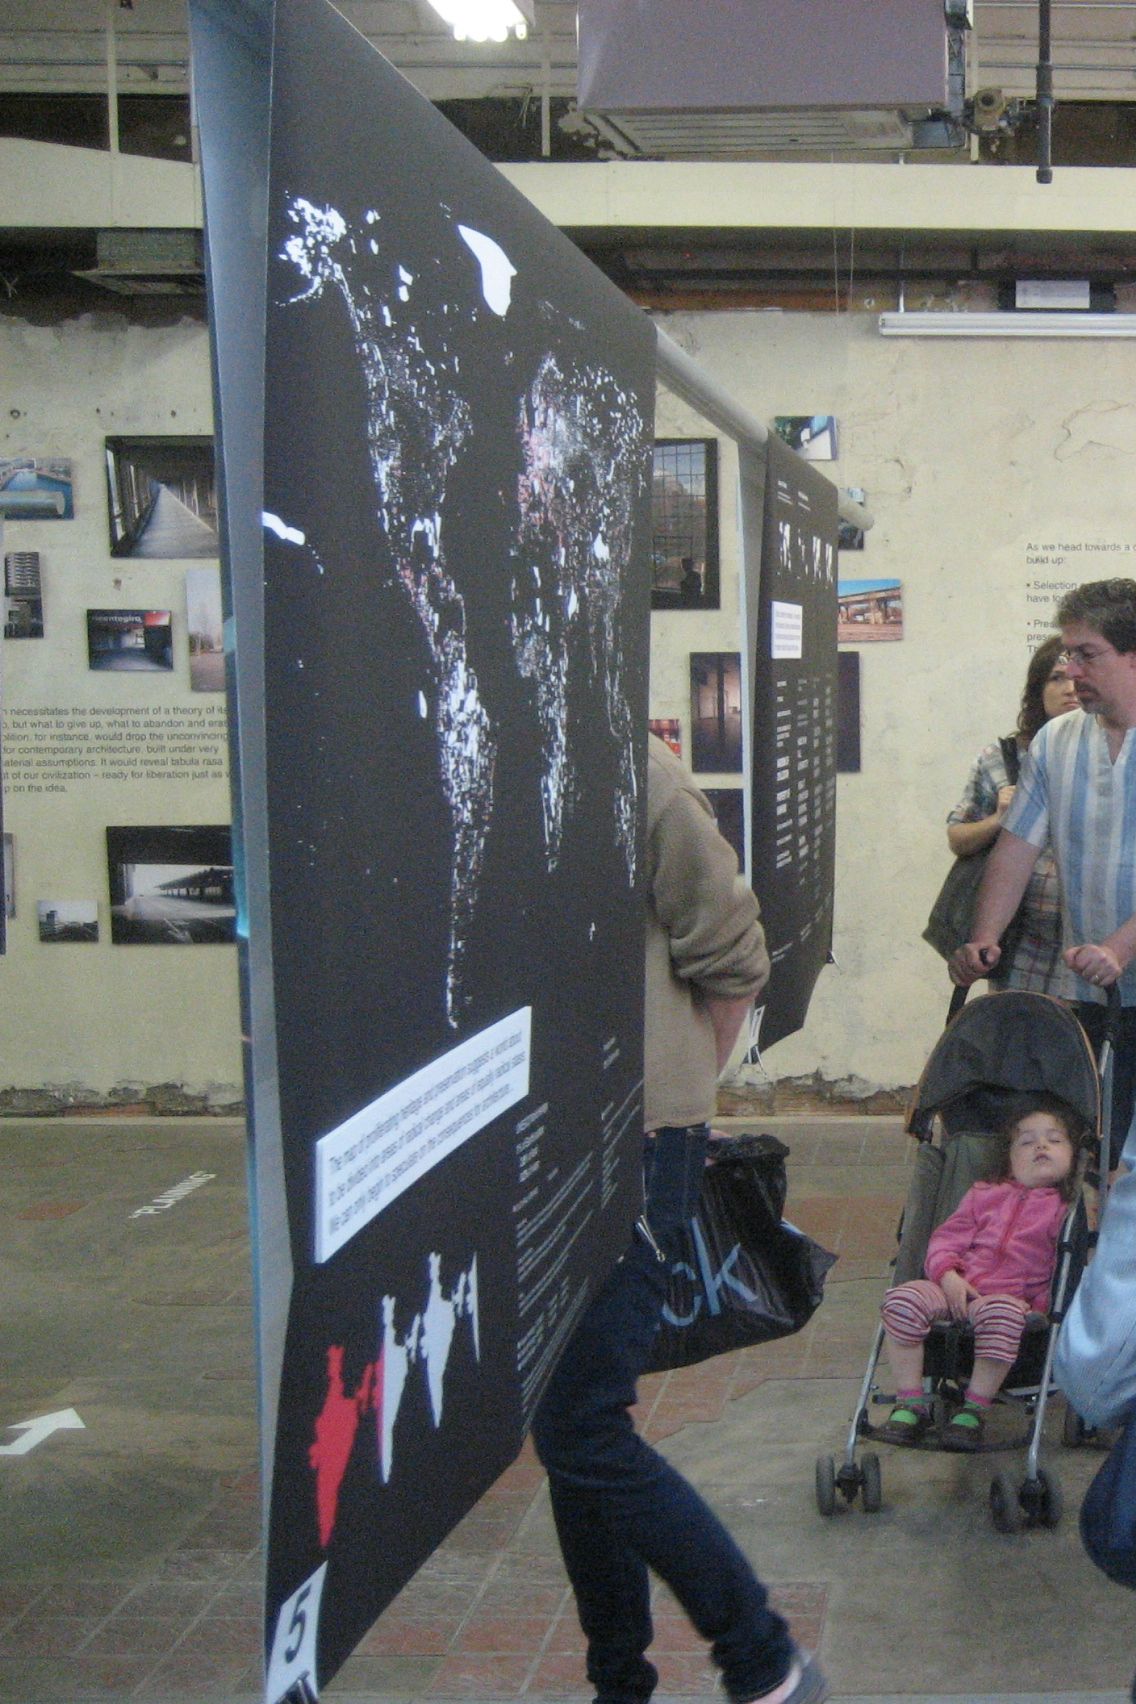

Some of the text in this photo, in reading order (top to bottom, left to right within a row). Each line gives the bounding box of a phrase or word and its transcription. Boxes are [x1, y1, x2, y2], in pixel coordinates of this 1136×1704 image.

[1058, 542, 1081, 551] head
[1085, 542, 1121, 551] towards
[1034, 581, 1077, 590] Selection
[72, 707, 87, 715] the
[90, 706, 149, 716] development
[152, 706, 161, 715] of
[172, 706, 202, 716] theory
[30, 720, 53, 728] what
[67, 720, 87, 730] give
[106, 720, 129, 728] what
[144, 720, 184, 728] abandon
[187, 720, 206, 728] and
[126, 733, 146, 741] drop
[149, 732, 164, 740] the
[18, 746, 83, 755] contemporary
[169, 745, 195, 753] under
[110, 758, 137, 766] would
[42, 772, 91, 780] civilization
[102, 771, 128, 780] ready
[146, 771, 189, 779] liberation
[285, 1583, 311, 1664] 5
